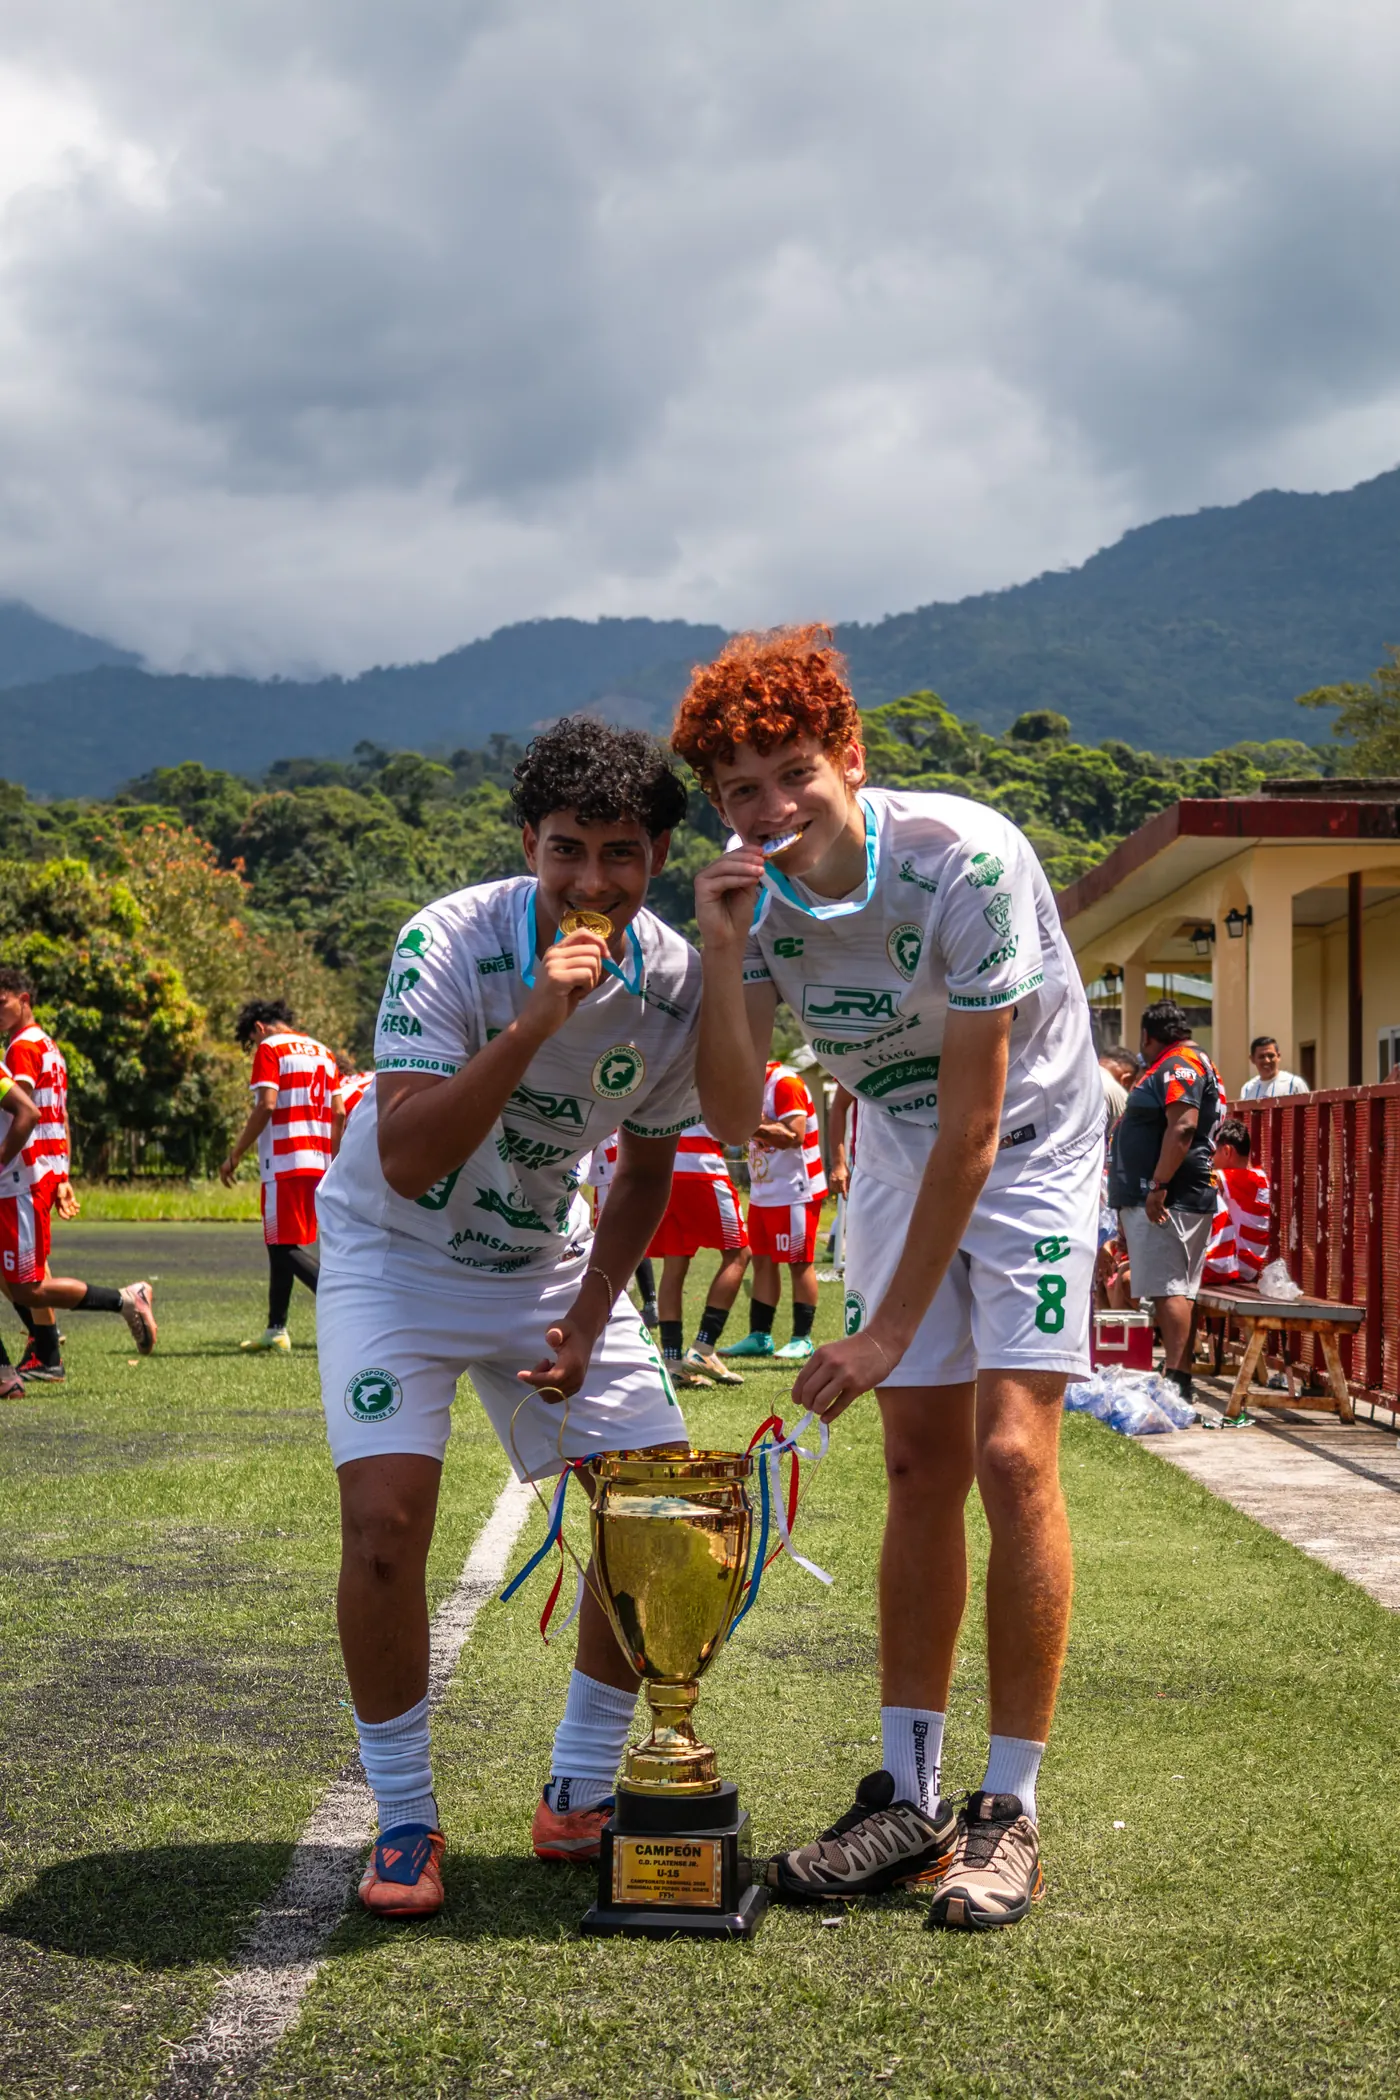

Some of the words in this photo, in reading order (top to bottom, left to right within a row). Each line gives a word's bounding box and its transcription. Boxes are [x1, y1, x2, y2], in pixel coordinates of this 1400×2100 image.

[808, 990, 898, 1018] JRA
[409, 1059, 440, 1070] SOLO
[442, 1062, 456, 1074] UN
[599, 1051, 613, 1065] CLUB
[614, 1047, 642, 1068] DEPORTIVO
[864, 1071, 894, 1096] Sweet
[906, 1064, 938, 1077] Lovely
[596, 1084, 623, 1097] PLATENSE
[888, 1093, 937, 1116] NSPO
[776, 1233, 790, 1252] 10
[4, 1250, 15, 1271] 6
[1035, 1274, 1067, 1334] 8
[348, 1377, 360, 1393] CLUB
[360, 1370, 397, 1388] DEPORTIVO
[353, 1410, 387, 1420] PLATENSE
[388, 1406, 396, 1414] JR
[635, 1843, 702, 1858] CAMPEÓN
[653, 1859, 687, 1867] PLATENSE
[688, 1860, 699, 1868] JR.
[657, 1869, 680, 1878] U-15
